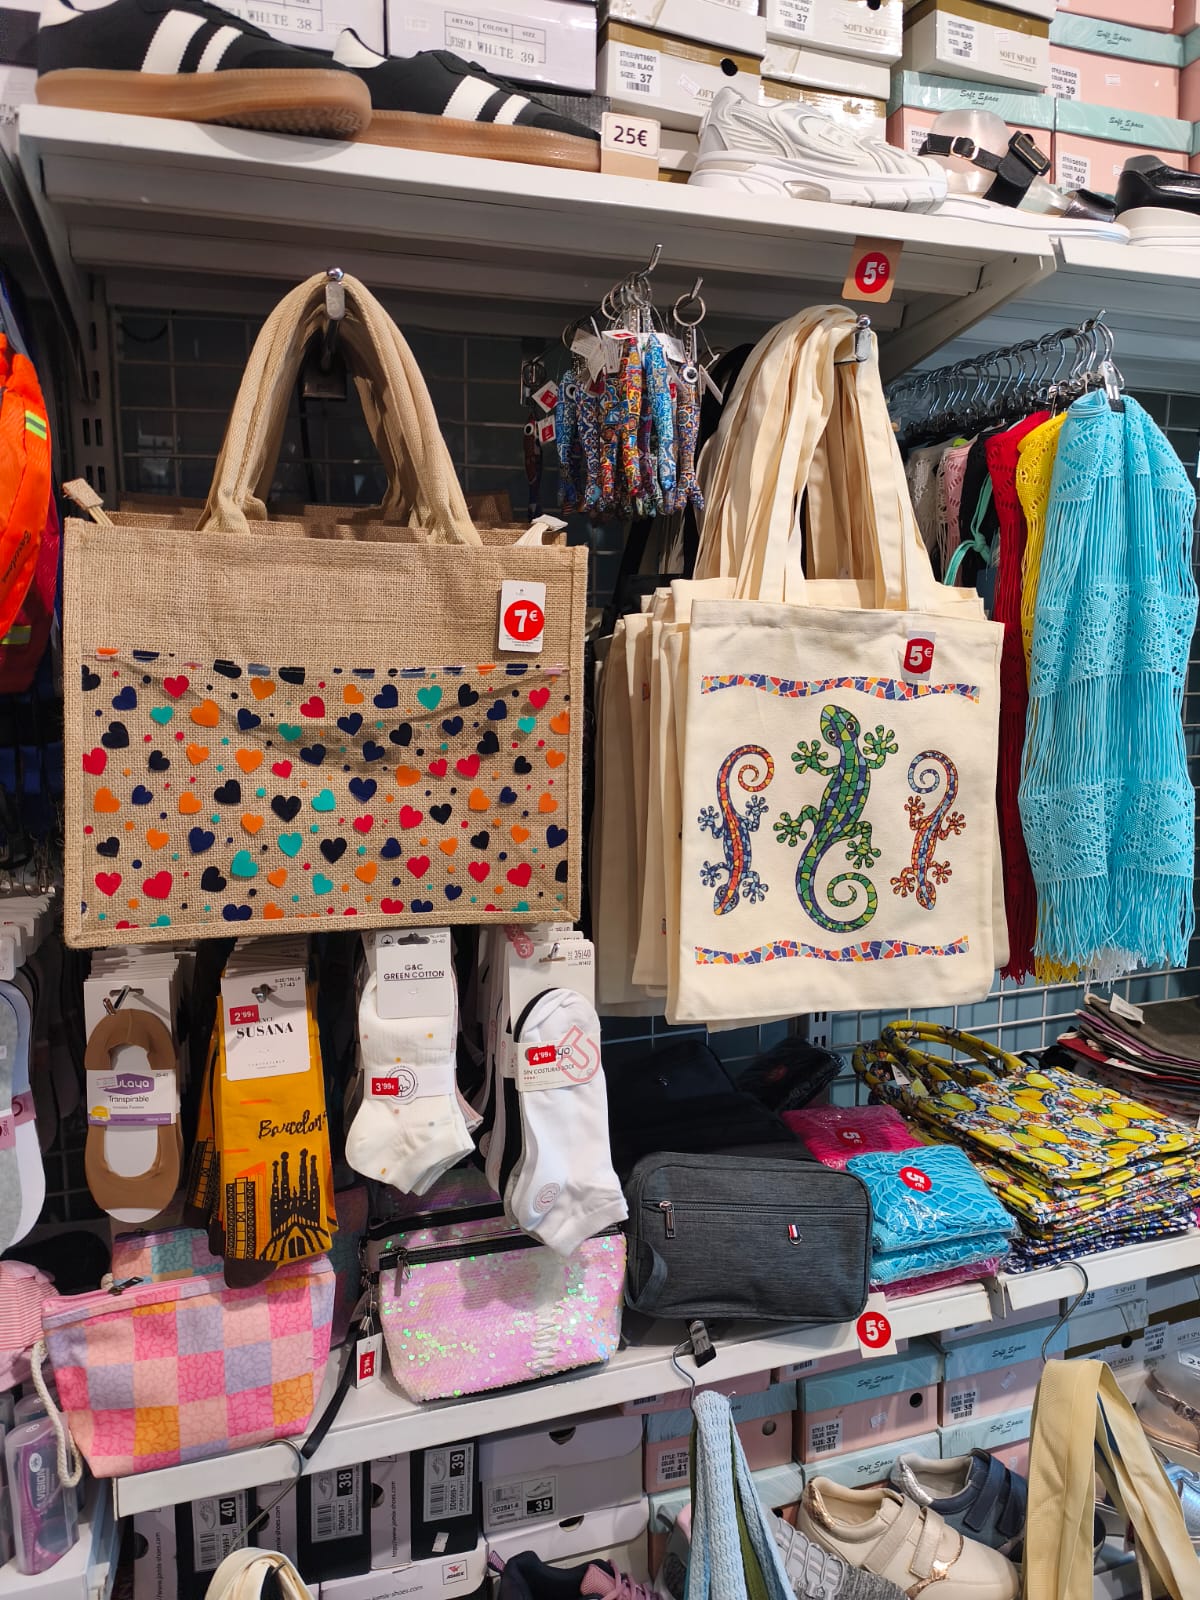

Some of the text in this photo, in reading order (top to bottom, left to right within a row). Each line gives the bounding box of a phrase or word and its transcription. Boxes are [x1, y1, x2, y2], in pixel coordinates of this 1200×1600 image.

[247, 10, 312, 30] WHITE 38
[796, 13, 808, 23] 37
[477, 41, 514, 59] WHITE
[520, 51, 535, 64] 39
[637, 63, 654, 72] BLACK
[640, 73, 653, 84] 37
[1066, 86, 1076, 94] 39
[613, 125, 648, 147] 25€
[1075, 175, 1085, 184] 40
[863, 261, 887, 285] 5€
[514, 608, 538, 633] 7€
[909, 645, 933, 666] 5€
[384, 970, 445, 980] GREEN COTTON
[236, 1022, 294, 1039] SUSANA
[108, 1094, 150, 1104] Transpirable
[906, 1171, 925, 1189] 5€
[865, 1319, 886, 1341] 5€
[826, 1436, 836, 1444] 37
[452, 1453, 464, 1469] 39
[338, 1472, 352, 1489] 38
[221, 1501, 234, 1517] 40
[535, 1498, 551, 1512] 39
